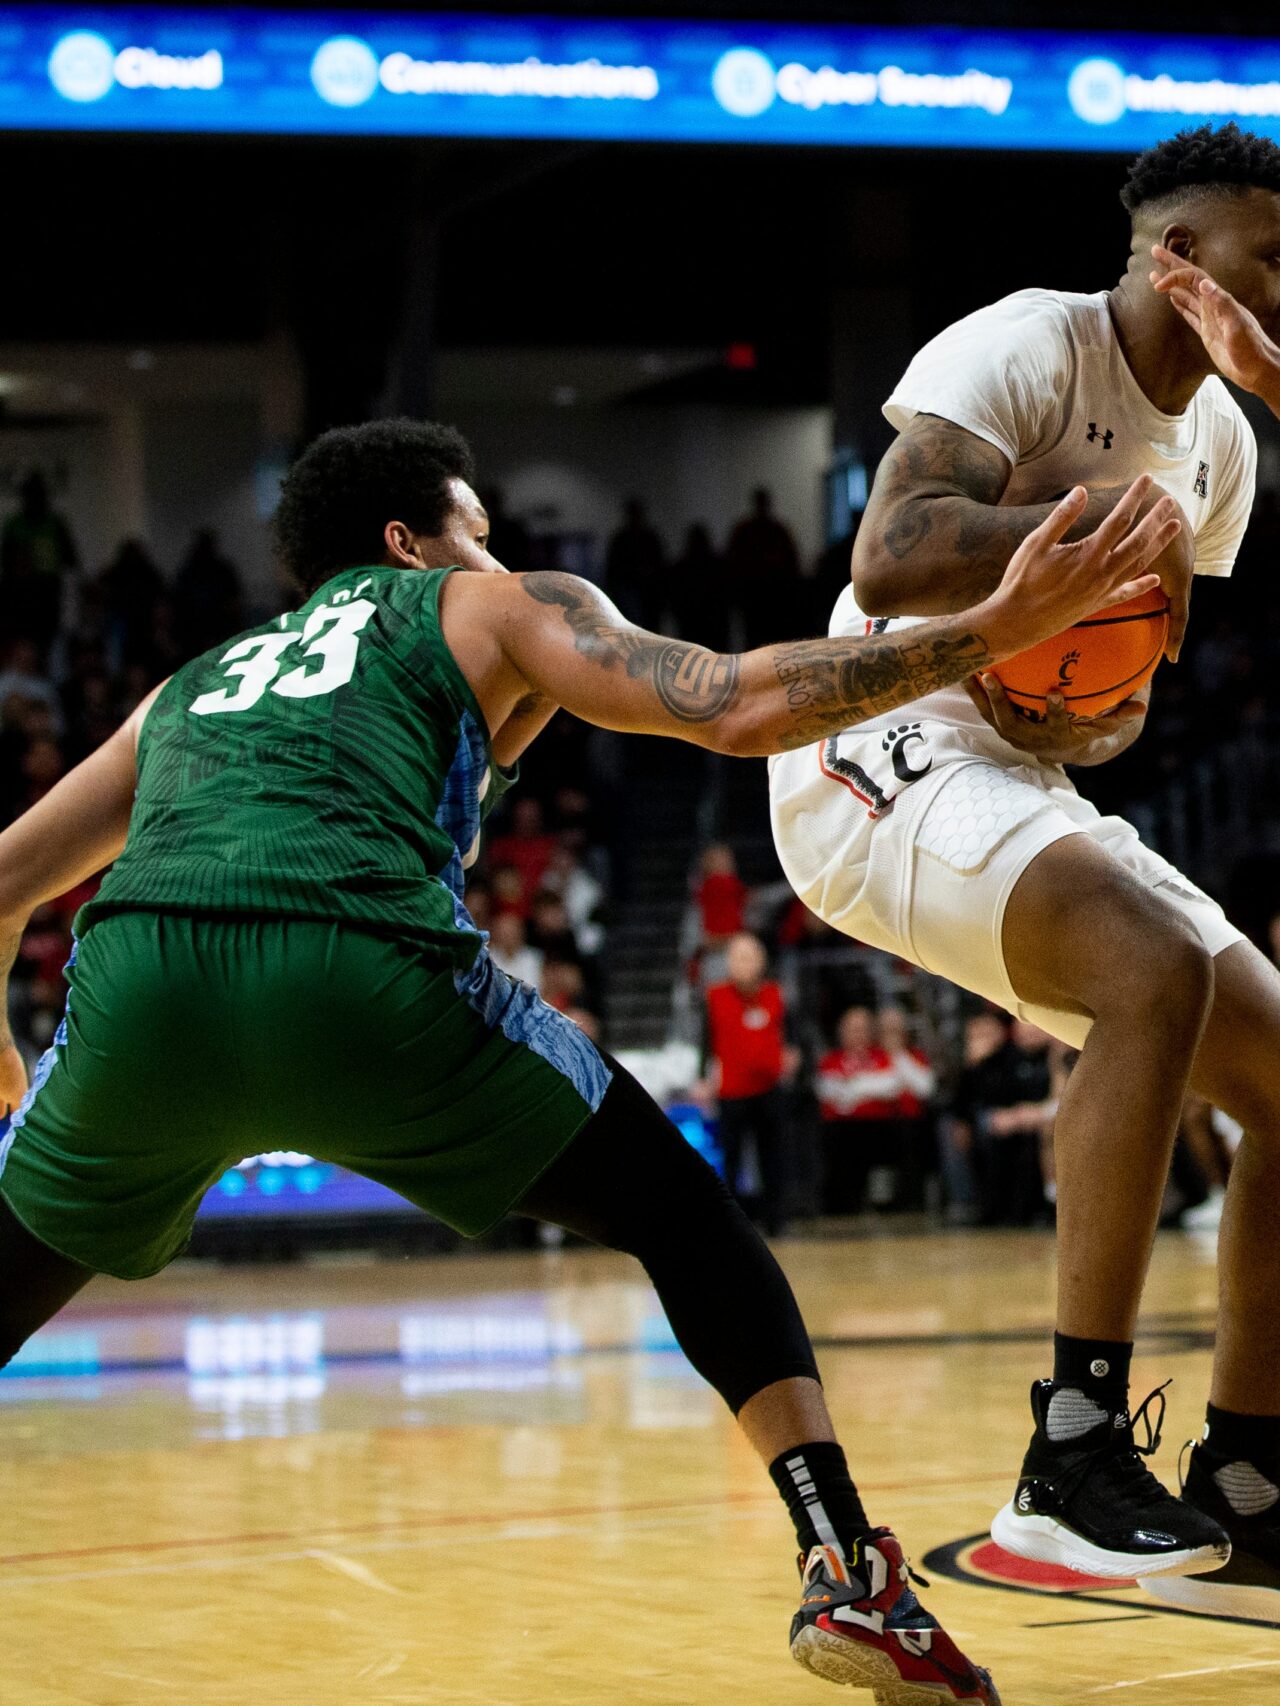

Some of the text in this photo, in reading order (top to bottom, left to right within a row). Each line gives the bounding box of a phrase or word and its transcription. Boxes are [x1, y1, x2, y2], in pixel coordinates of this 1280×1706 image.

[114, 48, 222, 90] Cloud
[380, 53, 659, 100] Communications
[189, 598, 378, 716] 33
